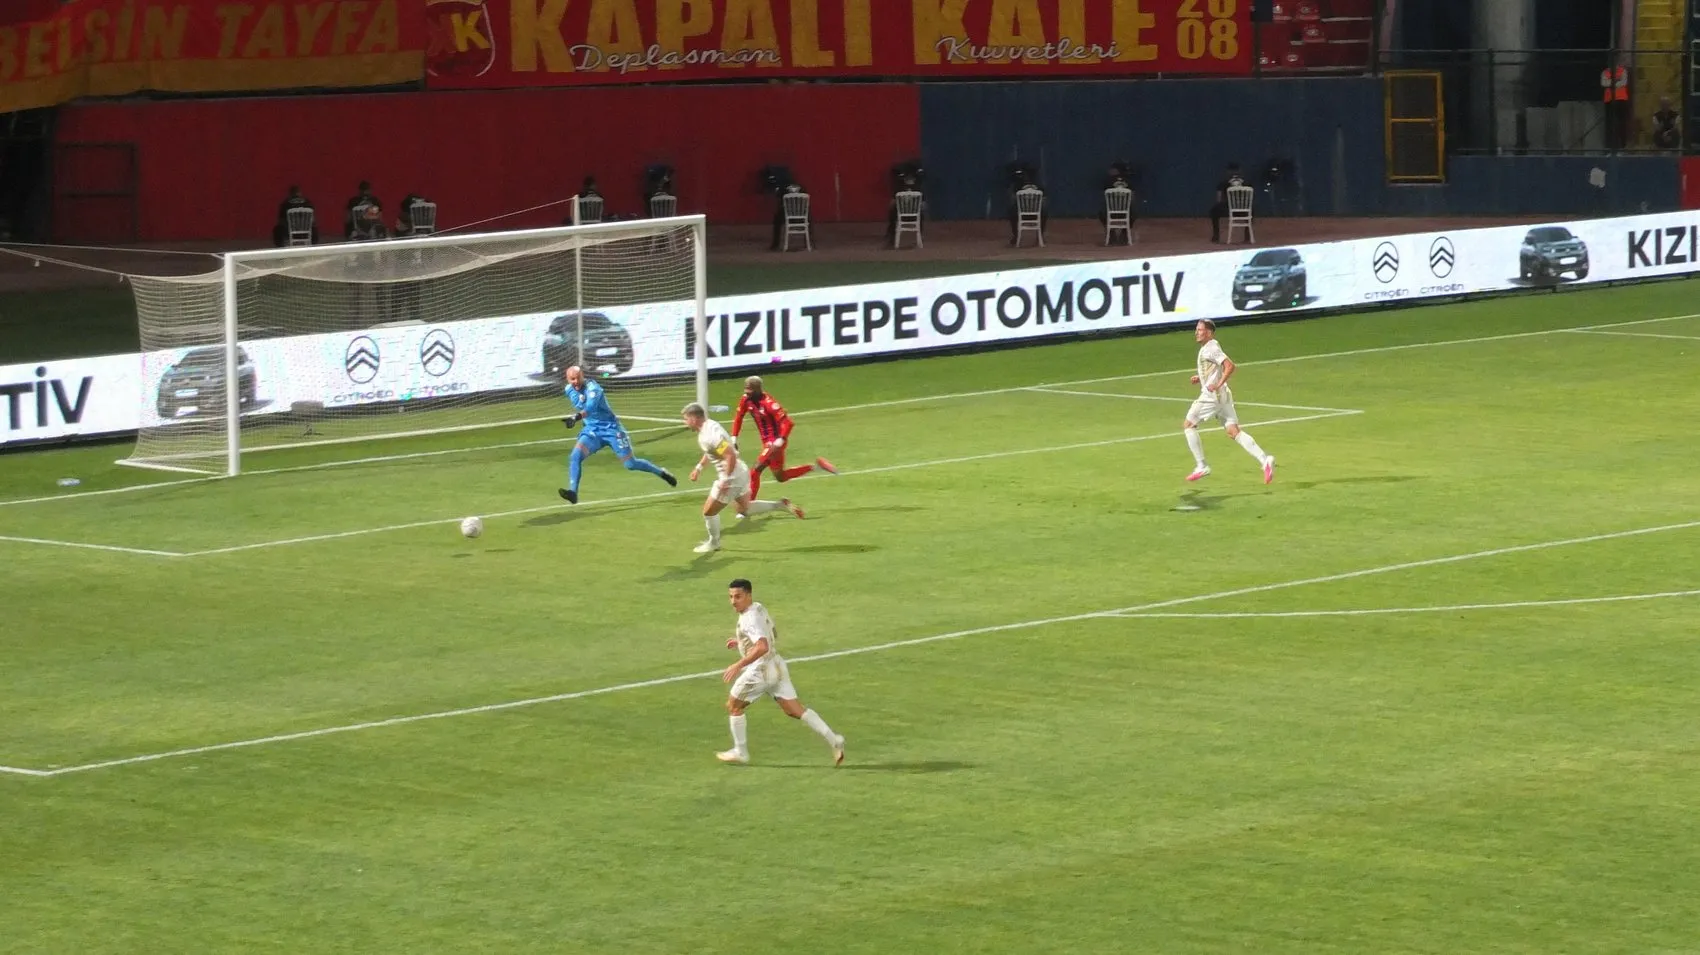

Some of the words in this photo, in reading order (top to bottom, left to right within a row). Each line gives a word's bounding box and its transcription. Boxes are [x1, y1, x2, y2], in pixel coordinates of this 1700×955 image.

[216, 2, 399, 58] TAYFA
[511, 0, 872, 72] KAPALI
[914, 0, 1159, 65] KALE
[570, 44, 782, 74] Deplasman
[935, 36, 1121, 61] Kuvvetleri
[1177, 19, 1238, 60] 08
[1628, 225, 1697, 268] KIZI
[685, 297, 918, 360] KIZILTEPE
[930, 261, 1184, 335] OTOMOTİV
[0, 366, 94, 430] TİV
